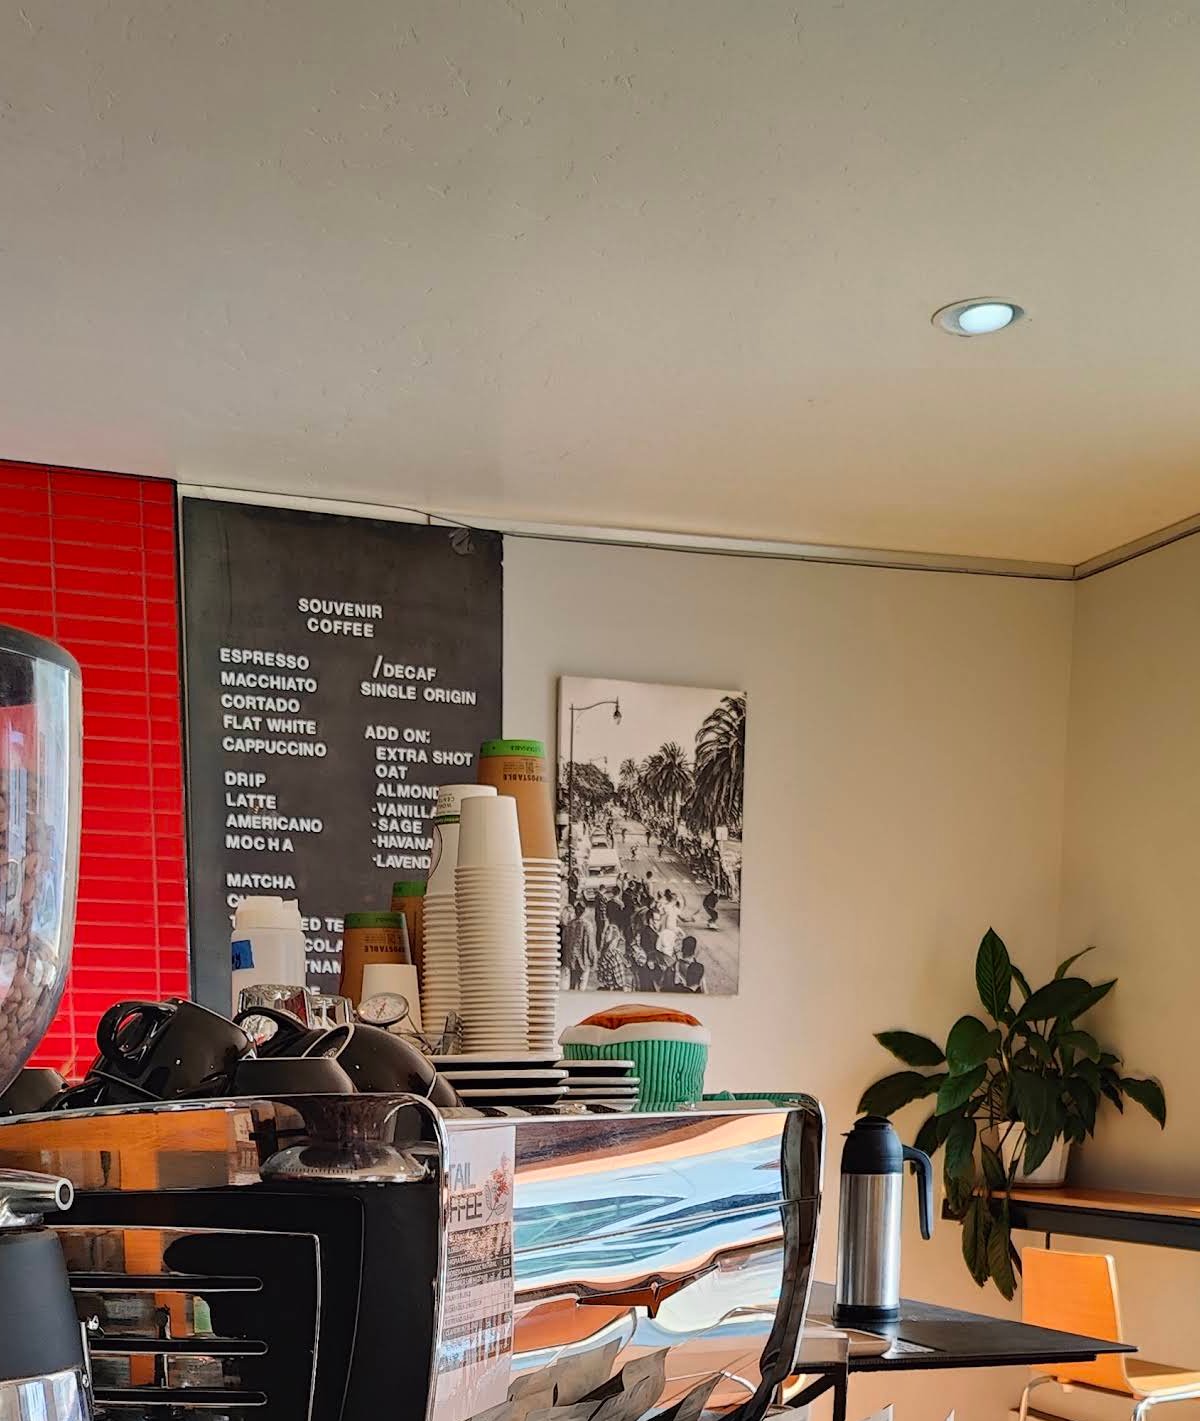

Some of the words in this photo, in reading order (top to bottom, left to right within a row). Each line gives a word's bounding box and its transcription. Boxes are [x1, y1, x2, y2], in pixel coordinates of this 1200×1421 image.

[298, 598, 383, 619] SOUVENIR
[307, 618, 374, 638] COFFEE
[220, 647, 310, 670] ESPRESSO
[221, 671, 318, 693] MACCHIATO
[360, 681, 417, 700] SINGLE
[423, 688, 477, 706] ORIGIN
[221, 694, 300, 713] CORTADO
[223, 714, 262, 731] FLAT
[266, 718, 317, 735] WHITE
[365, 725, 399, 740] ADD
[403, 728, 431, 744] ON:
[222, 736, 327, 757] CAPPUCCINO
[375, 746, 428, 763] EXTRA
[432, 750, 473, 766] SHOT
[224, 770, 267, 787] DRIP
[375, 764, 408, 780] OAT
[226, 792, 277, 809] LATTE
[376, 783, 439, 800] ALMOND
[226, 814, 323, 833] AMERICANO
[226, 834, 294, 852] MOCHA
[377, 854, 431, 869] LAVEND
[226, 873, 296, 889] MATCHA
